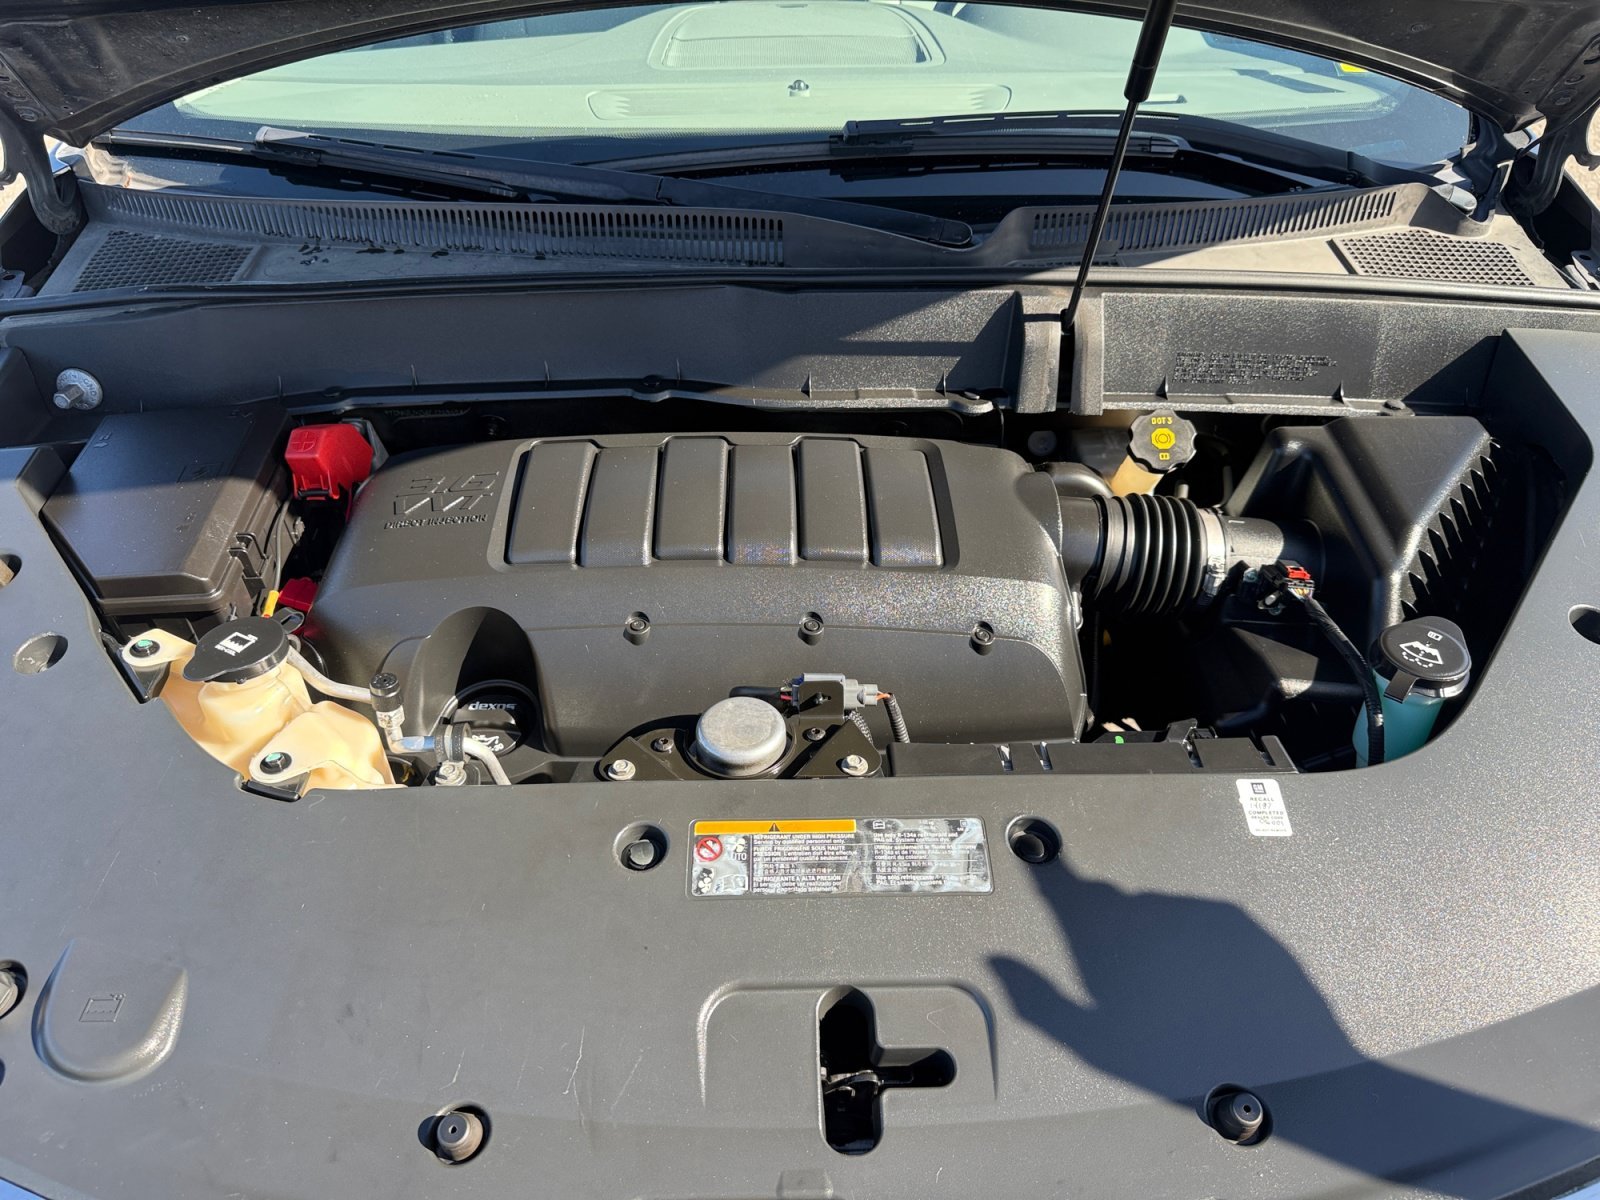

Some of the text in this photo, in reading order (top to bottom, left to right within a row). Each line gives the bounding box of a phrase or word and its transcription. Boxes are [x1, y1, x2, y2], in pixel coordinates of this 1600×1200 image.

[1167, 416, 1173, 424] 3
[384, 514, 488, 530] DIRECT INJECTION
[468, 701, 518, 711] dexos
